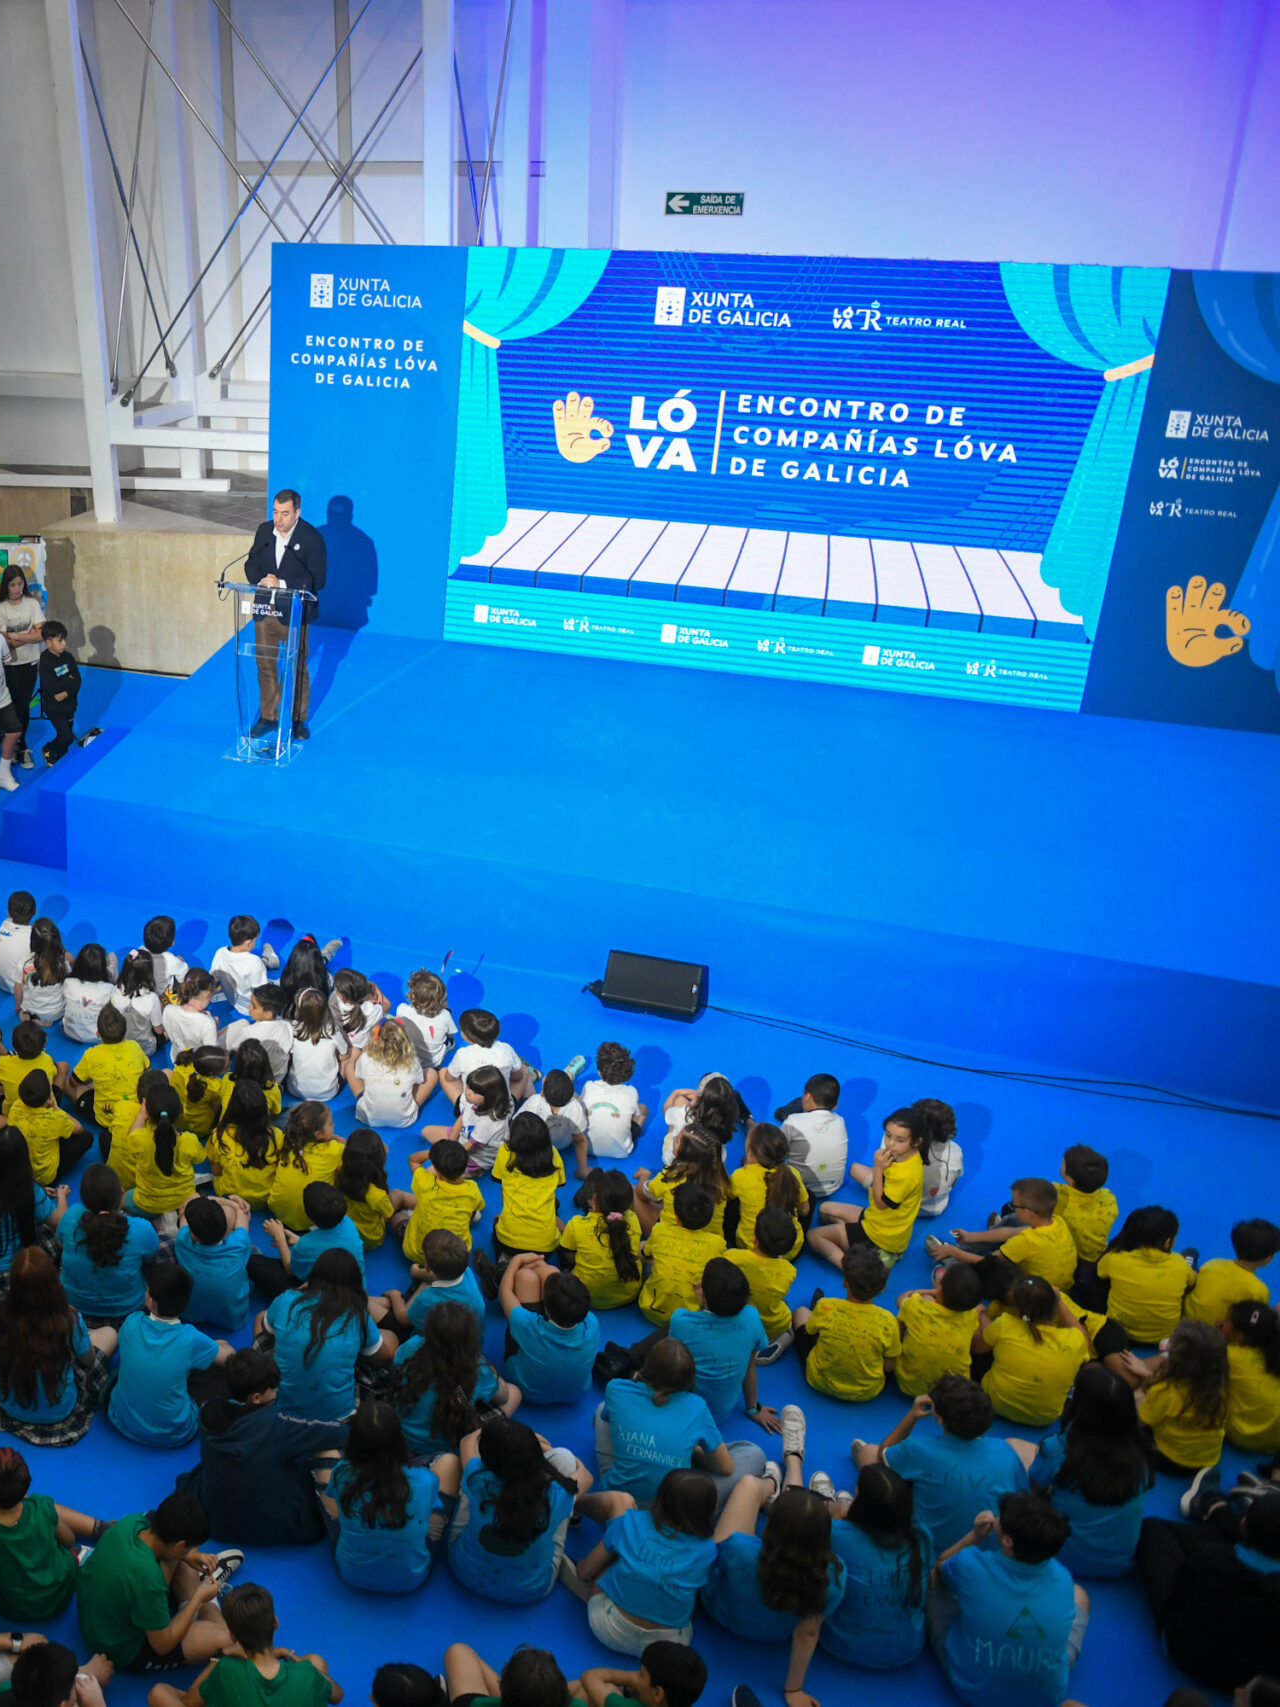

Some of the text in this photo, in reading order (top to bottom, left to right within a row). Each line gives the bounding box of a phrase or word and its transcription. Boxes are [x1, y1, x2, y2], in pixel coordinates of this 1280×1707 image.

[700, 194, 736, 204] SAÍDA DE
[693, 205, 741, 214] EMERXENCIA
[338, 277, 391, 292] XUNTA
[338, 293, 422, 309] DE GALICIA
[690, 291, 755, 309] XUNTA
[688, 309, 792, 328] DE GALICIA
[832, 319, 854, 330] VA
[885, 316, 932, 328] TEATRO
[936, 317, 967, 329] REAL
[305, 335, 424, 352] ENCONTRO DE
[291, 352, 438, 372] COMPAÑÍAS LÓVA
[315, 373, 411, 389] DE GALICIA
[629, 388, 698, 432] LÓ
[737, 393, 966, 427] ENCONTRO DE
[1194, 414, 1243, 428] XUNTA
[1191, 426, 1270, 442] DE GALICIA
[733, 424, 1019, 464] COMPAÑÍAS LÓVA
[624, 434, 698, 473] VA
[1159, 457, 1180, 469] LÓ
[1189, 458, 1234, 467] ENCONTRO
[729, 456, 911, 488] DE GALICIA
[1158, 468, 1178, 479] VA
[1187, 466, 1261, 477] COMPAÑÍAS LÓVA
[1199, 475, 1234, 483] GALICIA
[1149, 508, 1163, 516] VA
[1185, 508, 1215, 516] TEATRO
[1217, 510, 1238, 518] REAL
[260, 609, 283, 617] GALICIA
[490, 607, 520, 617] XUNTA
[489, 615, 537, 627] DE GALICIA
[592, 624, 616, 632] TEATRO
[679, 627, 710, 638] XUNTA
[678, 635, 728, 648] DE GALICIA
[788, 645, 814, 654] TEATRO
[882, 649, 916, 660] XUNTA
[881, 657, 935, 670] DE GALICIA
[998, 668, 1027, 677] TEATRO
[626, 1444, 684, 1468] FERNANDEZ
